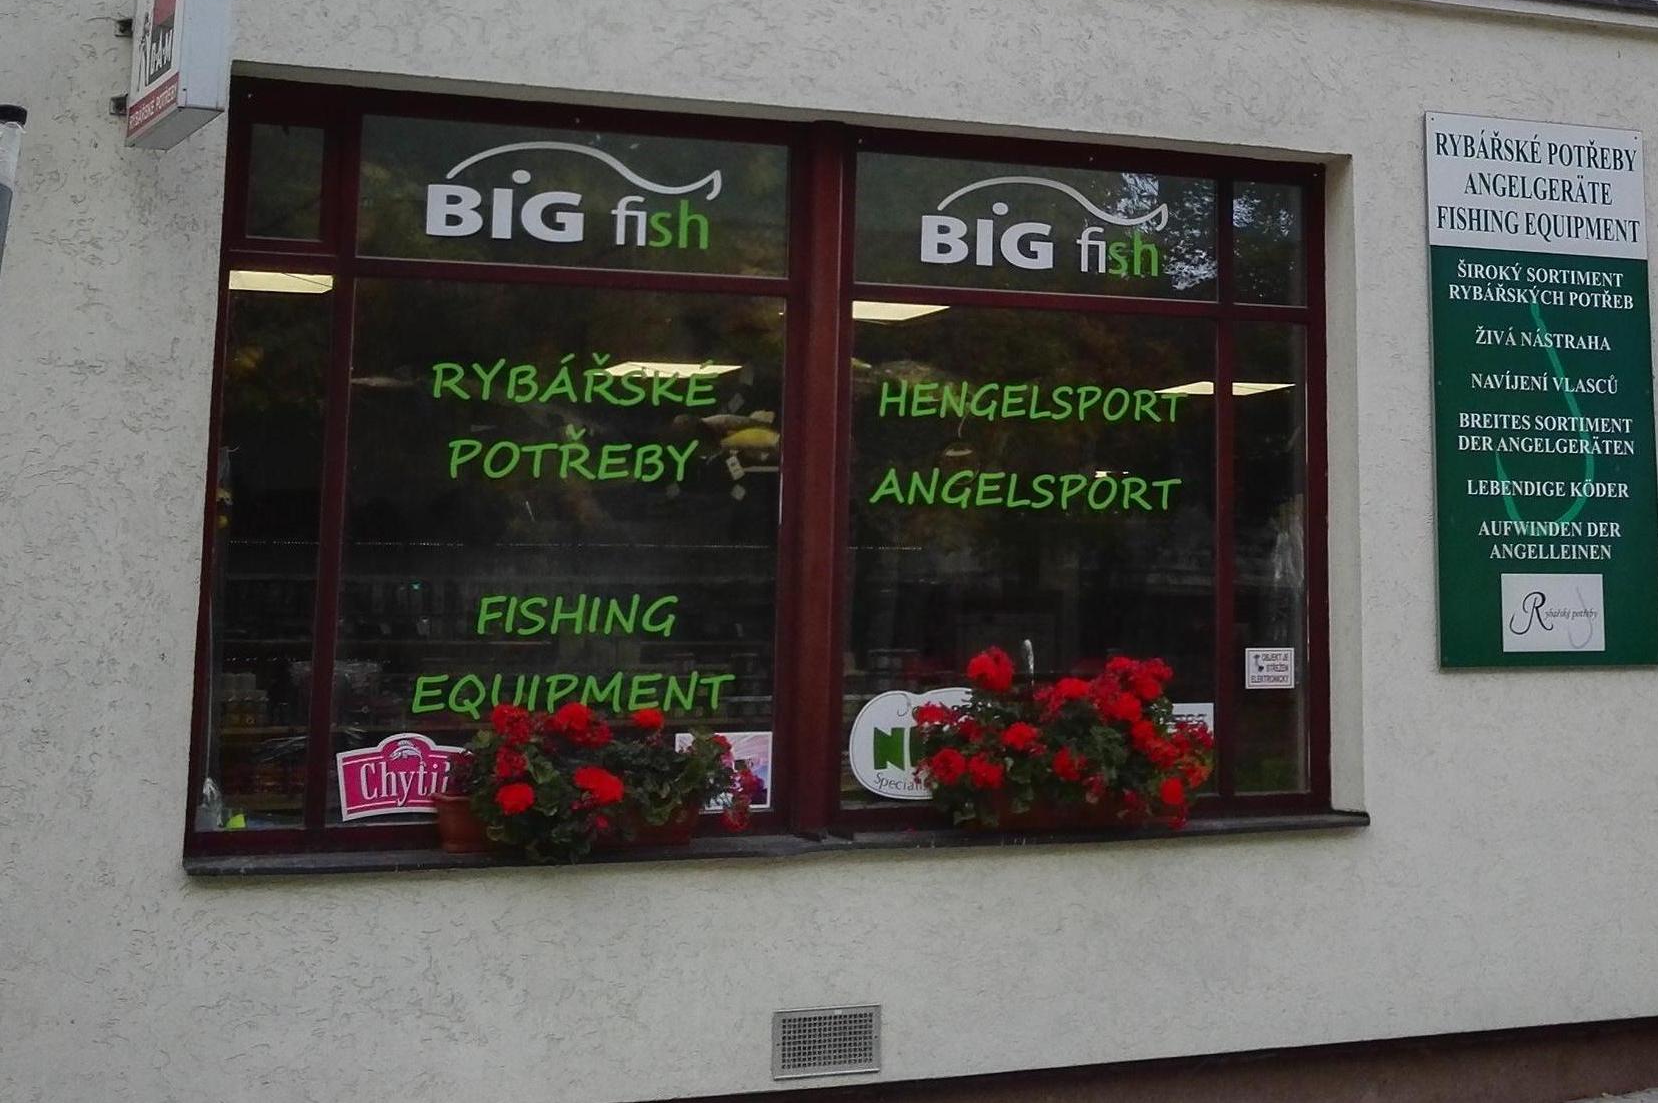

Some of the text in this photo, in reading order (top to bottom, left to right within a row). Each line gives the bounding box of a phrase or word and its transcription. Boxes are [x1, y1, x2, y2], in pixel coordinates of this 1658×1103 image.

[1435, 130, 1637, 172] RYBÁŘSKÉ POTŘEBY
[1464, 173, 1613, 205] ANGELGERÄTE
[425, 182, 710, 250] BIG fish
[1437, 205, 1640, 243] FISHING EQUIPMENT
[920, 213, 1160, 277] BIG fish
[1457, 259, 1624, 287] ŠIROKÝ SORTIMENT
[1449, 283, 1634, 310] RYBÁŘSKÝCH POTŘEB
[1475, 325, 1612, 351] ŽIVÁ NÁSTRAHA
[433, 353, 720, 407] RYBÁŘSKÉ
[1471, 371, 1618, 395] NAVÍJENÍ VLASCŮ
[879, 381, 1189, 424] HENGELSPORT
[1459, 412, 1633, 434] BREITES SORTIMENT
[449, 424, 699, 482] POTŘEBY
[1457, 435, 1635, 456] DER ANGELGERÄTEN
[869, 468, 1182, 511] ANGELSPORT
[1467, 478, 1629, 499] LEBENDIGE KÖDER
[1478, 520, 1621, 538] AUFWINDEN DER
[1490, 543, 1612, 560] ANGELLEINEN
[477, 594, 679, 637] FISHING
[411, 671, 735, 719] EQUIPMENT
